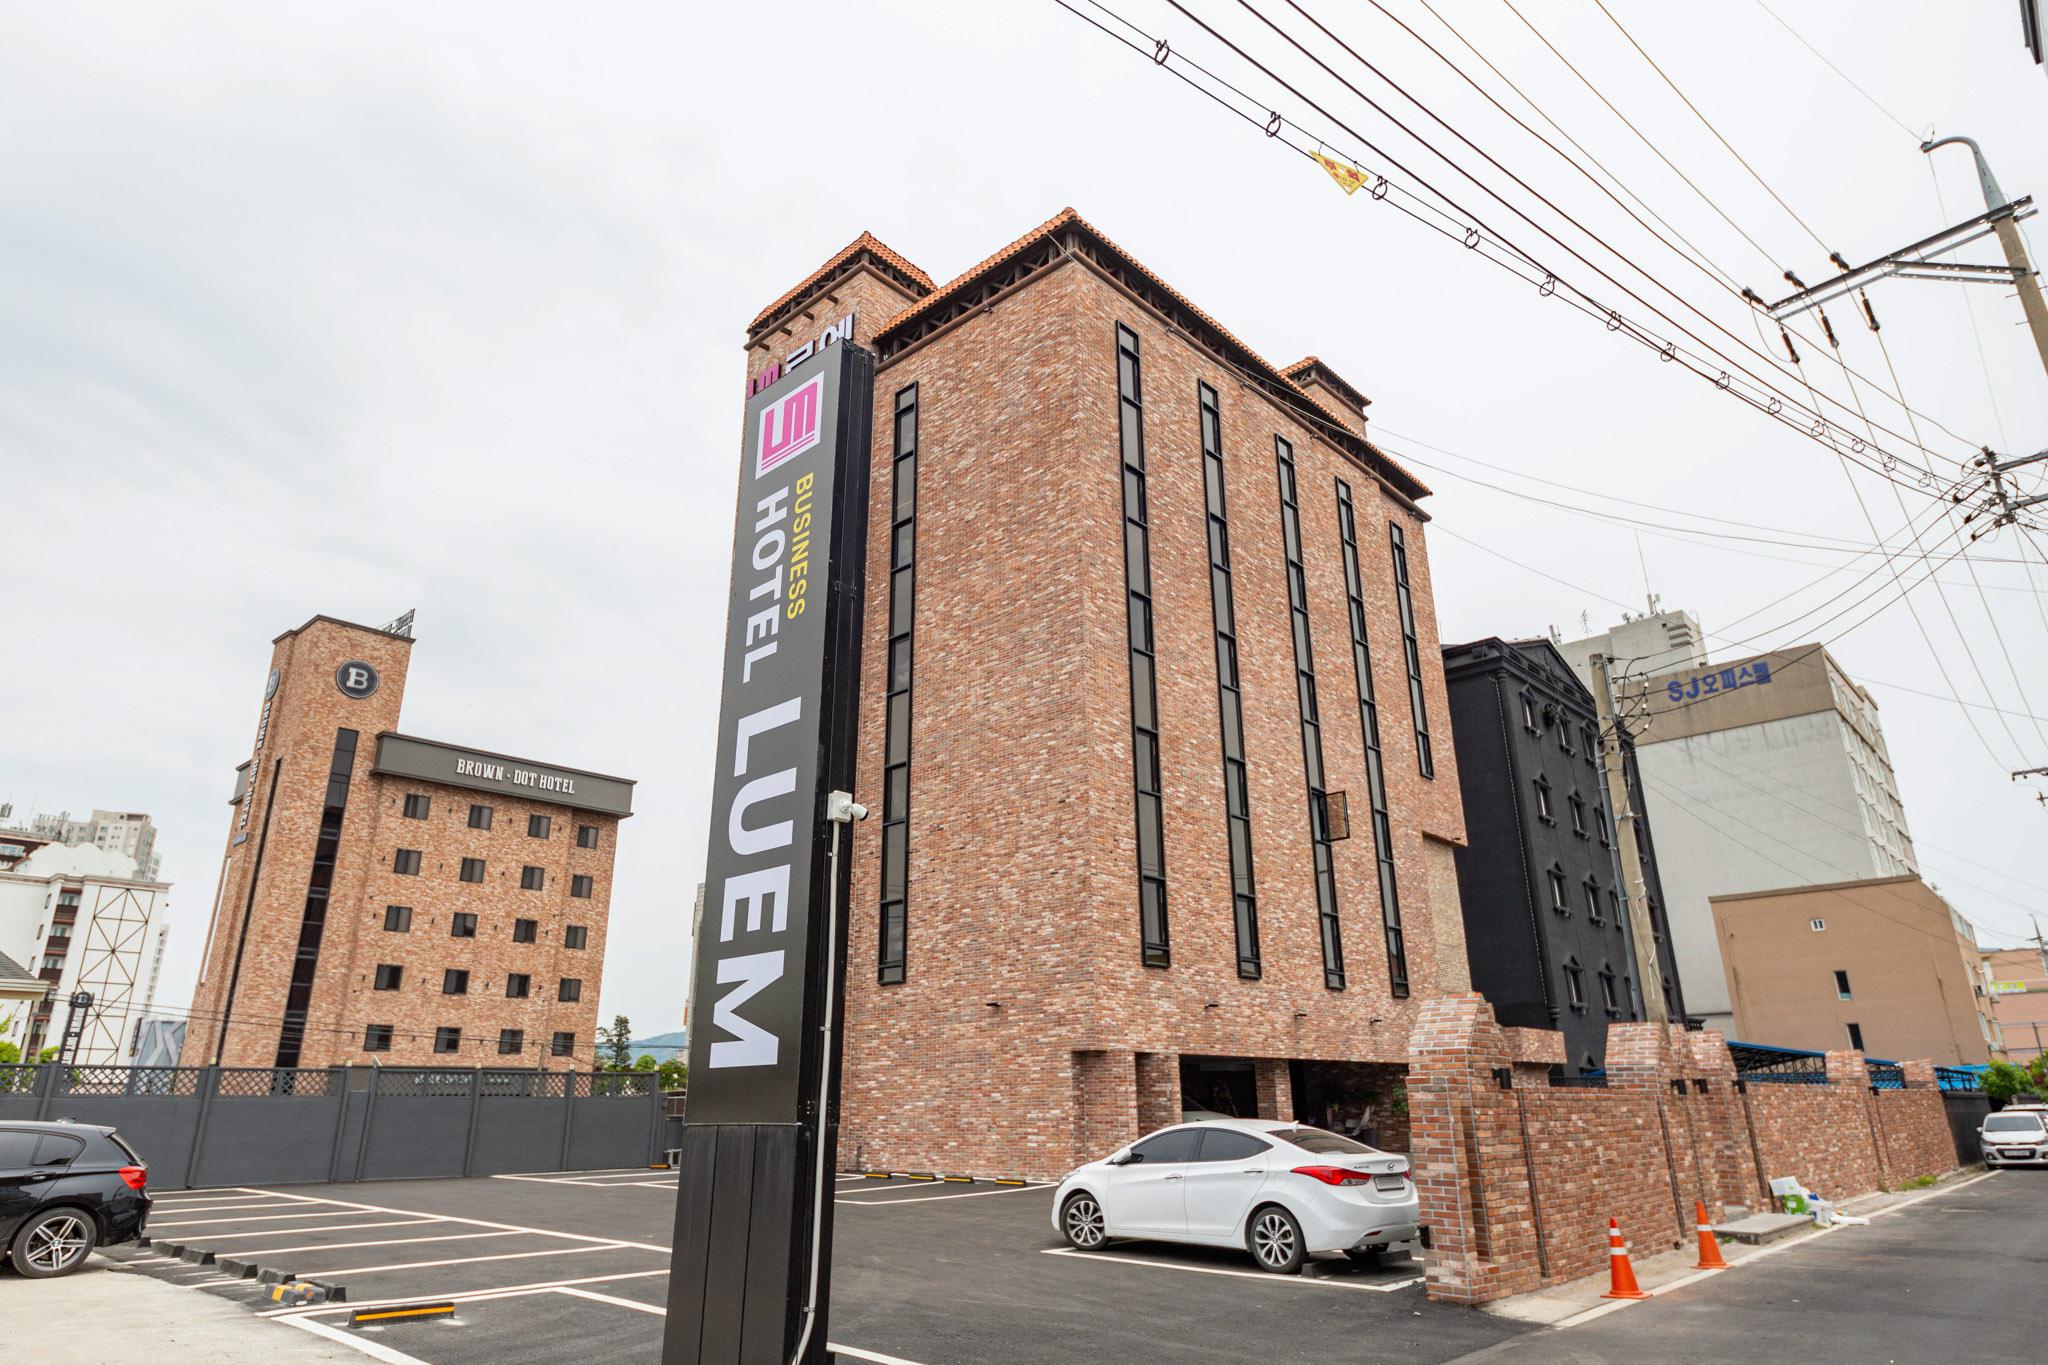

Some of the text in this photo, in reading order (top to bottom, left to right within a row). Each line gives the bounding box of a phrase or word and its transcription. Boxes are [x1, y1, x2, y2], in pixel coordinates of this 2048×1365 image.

[786, 471, 814, 620] BUSINESS
[346, 667, 369, 690] B
[456, 758, 575, 794] BROWN DOT HOTEL
[708, 486, 802, 1069] HOTEL LUEM
